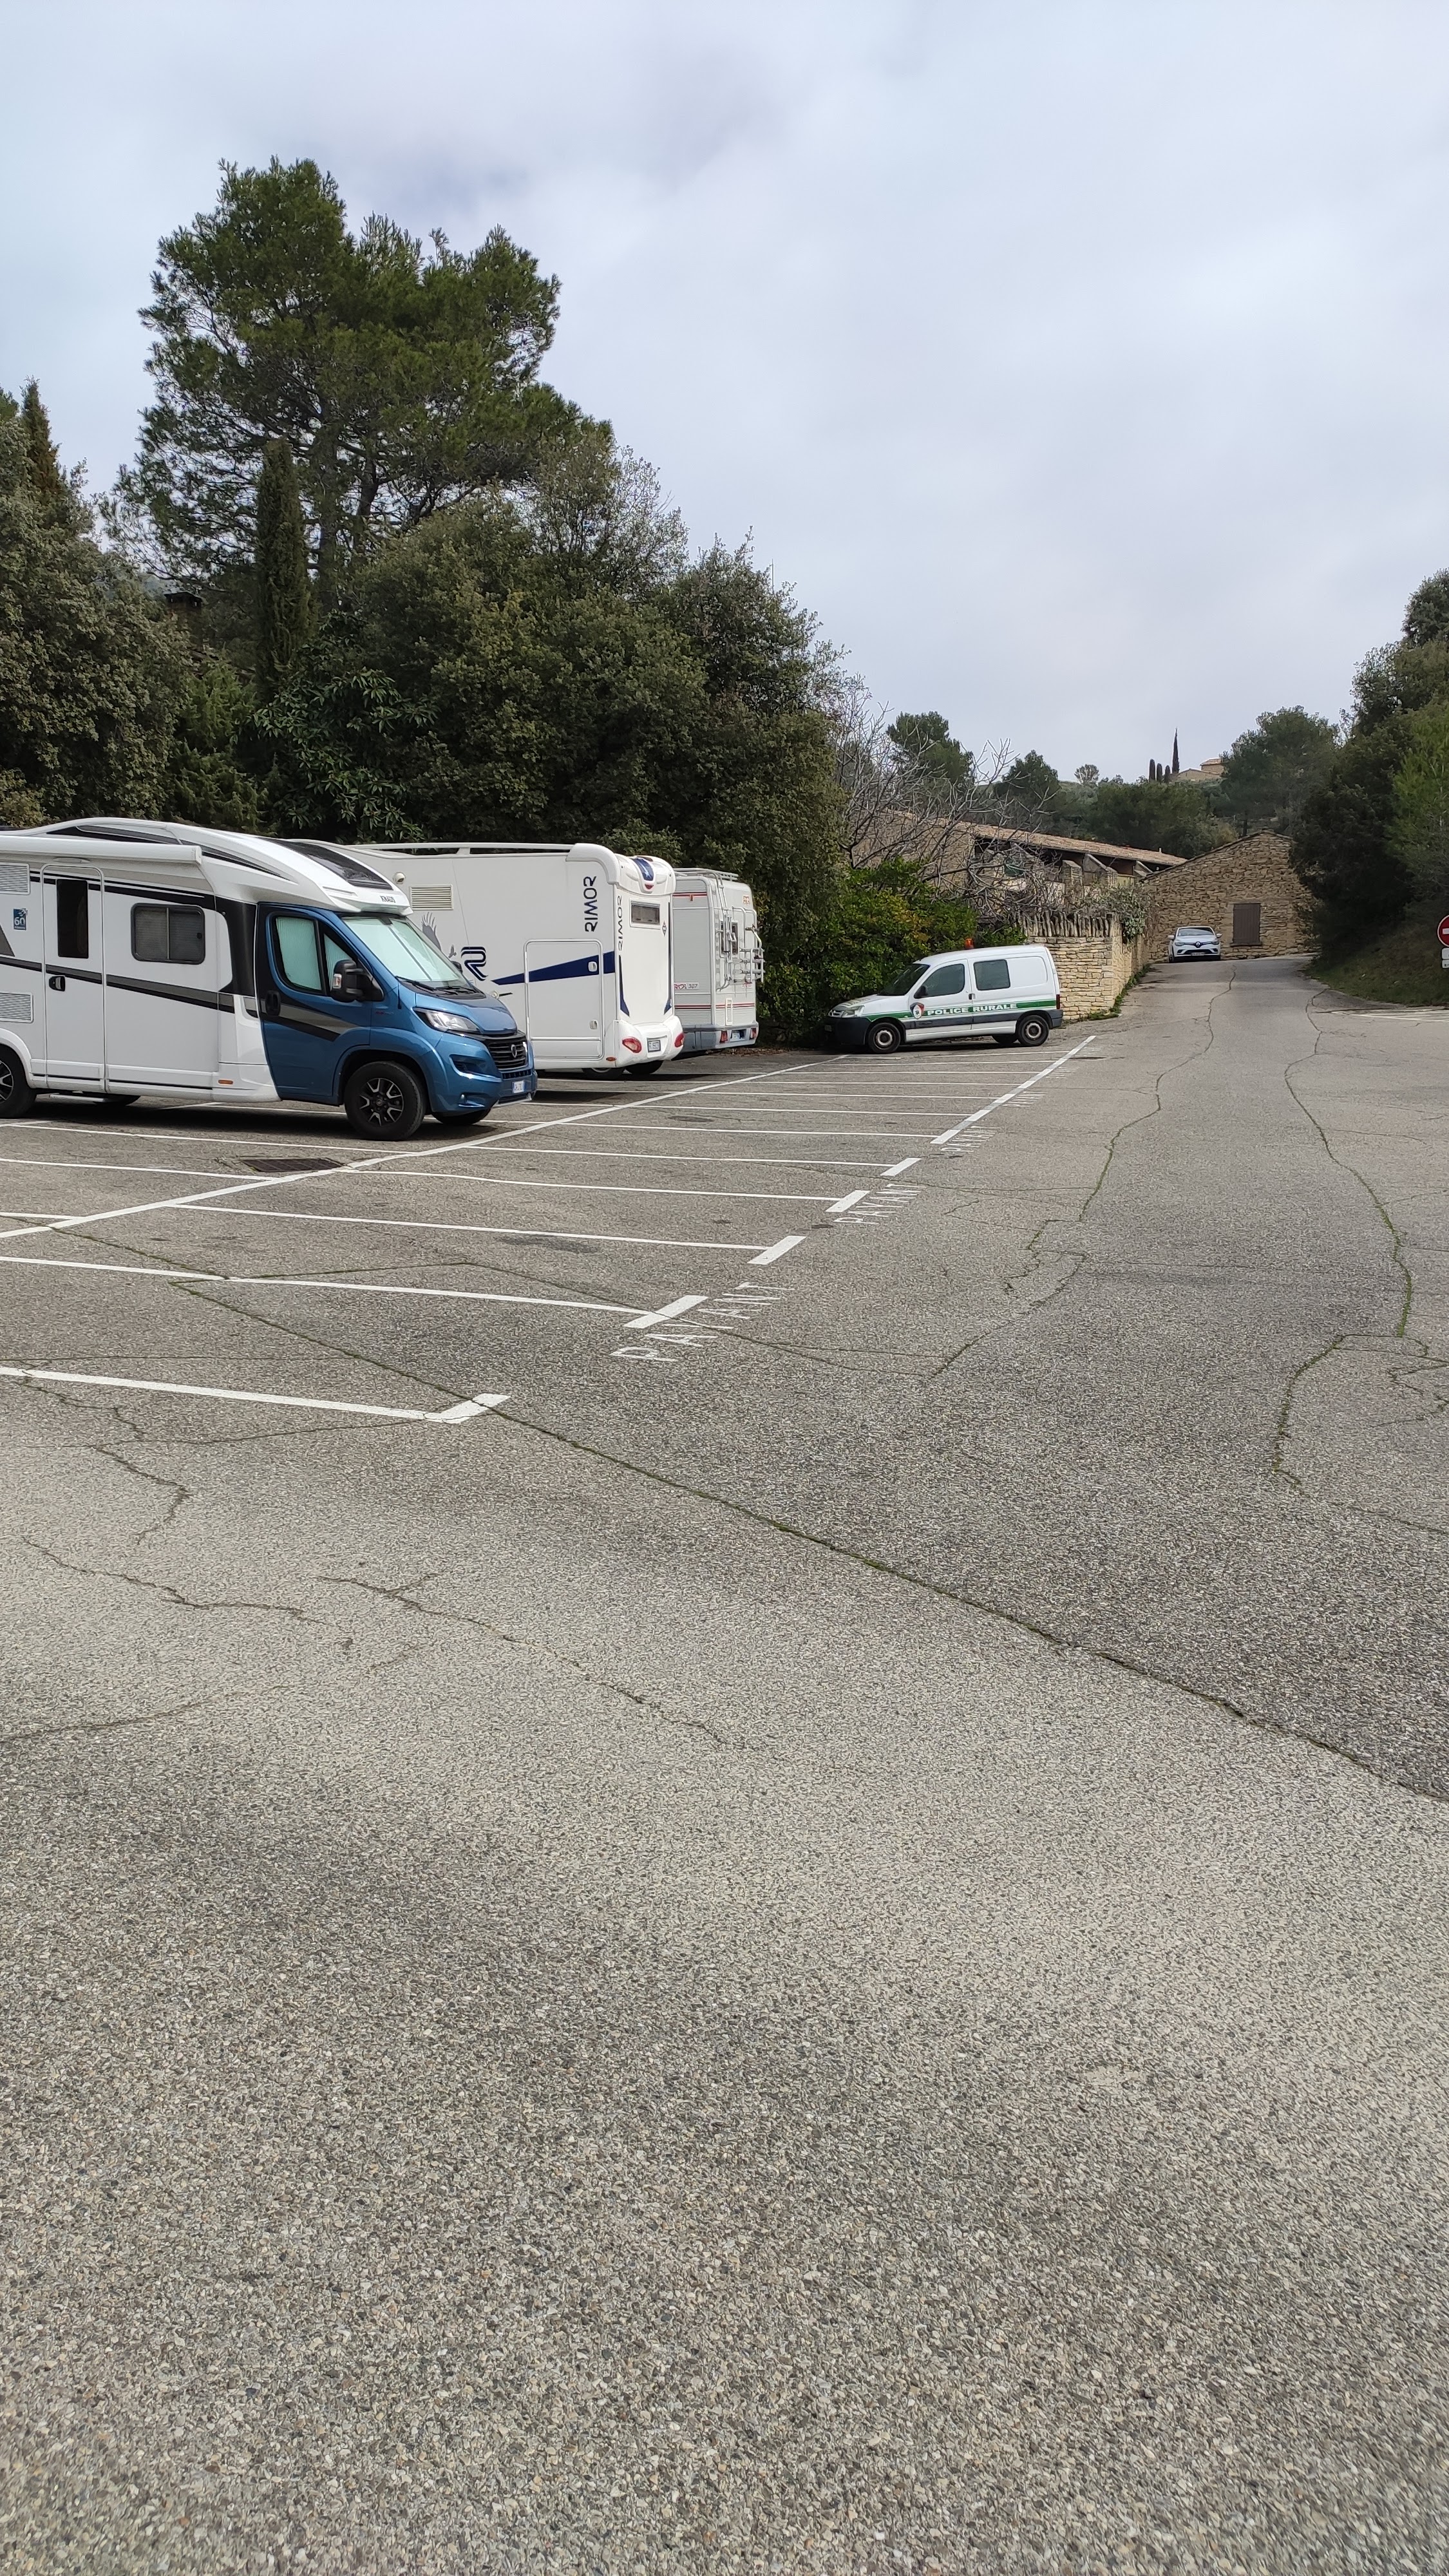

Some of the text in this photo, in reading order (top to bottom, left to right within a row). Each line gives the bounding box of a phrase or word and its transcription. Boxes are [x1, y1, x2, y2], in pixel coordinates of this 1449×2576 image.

[583, 875, 598, 933] RIMOR
[927, 1003, 1018, 1016] POLICE RURALE
[833, 1183, 927, 1224] PAYANT
[610, 1281, 795, 1361] PAYANT
